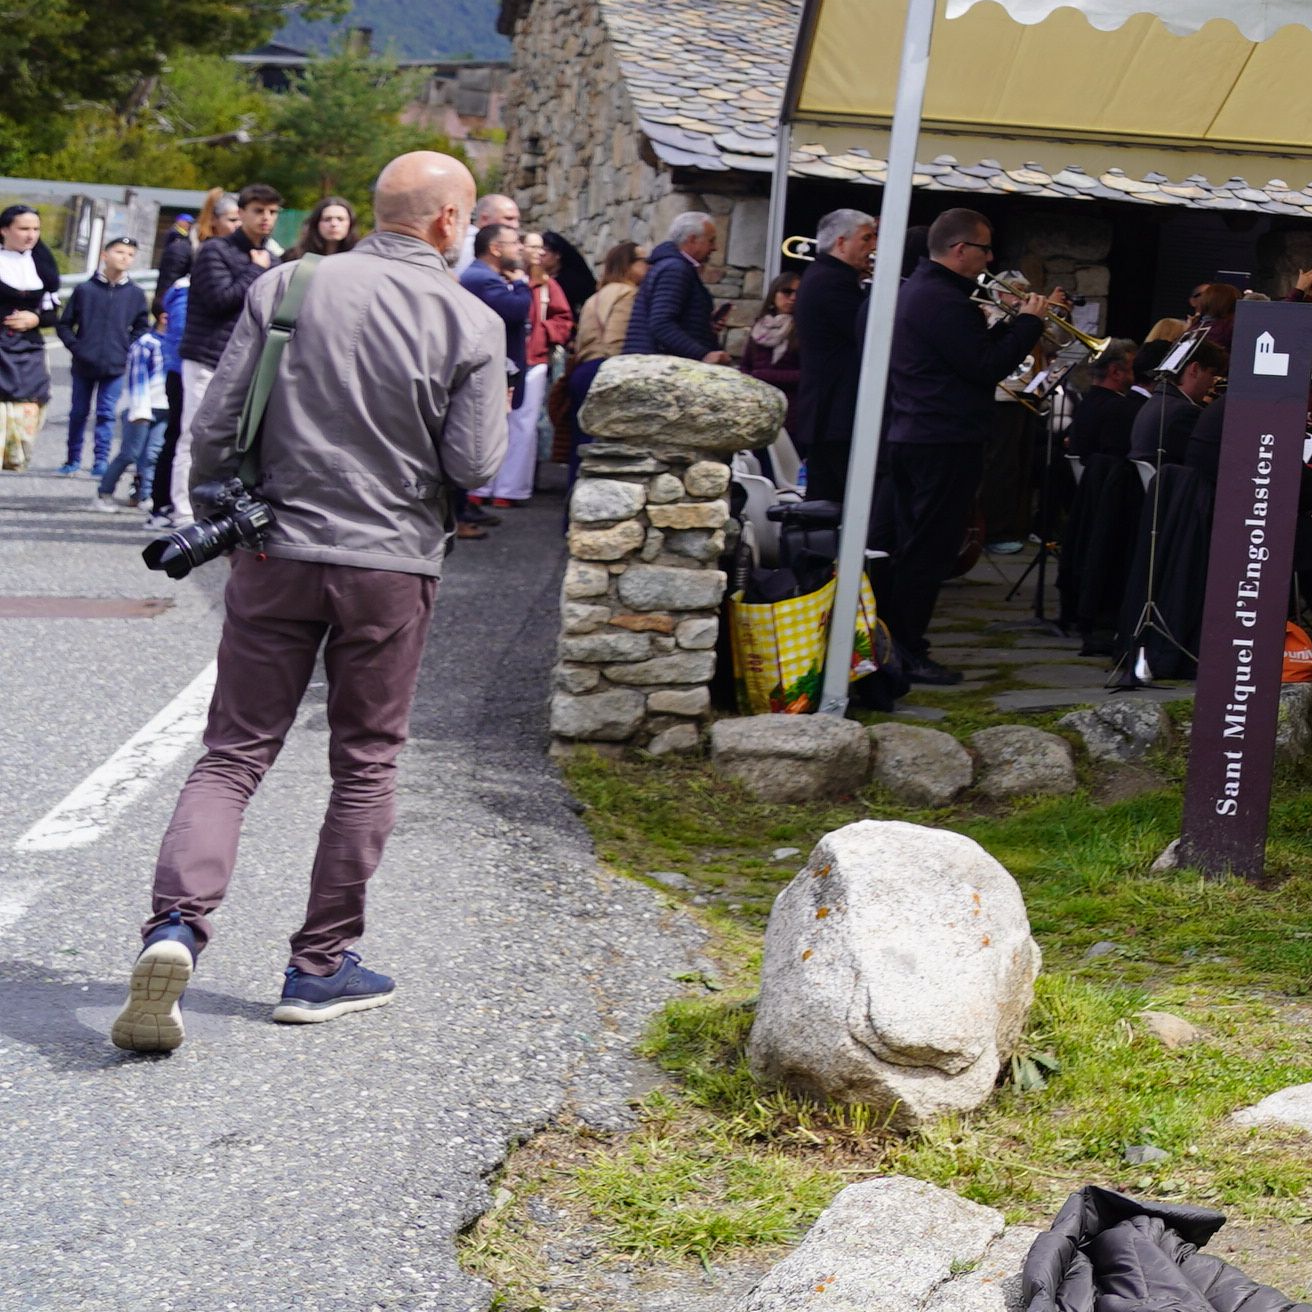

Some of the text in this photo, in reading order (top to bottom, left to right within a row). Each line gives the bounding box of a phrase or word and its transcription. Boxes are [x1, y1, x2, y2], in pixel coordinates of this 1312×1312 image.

[1216, 432, 1276, 816] Sant Miquel d'Engolasters
